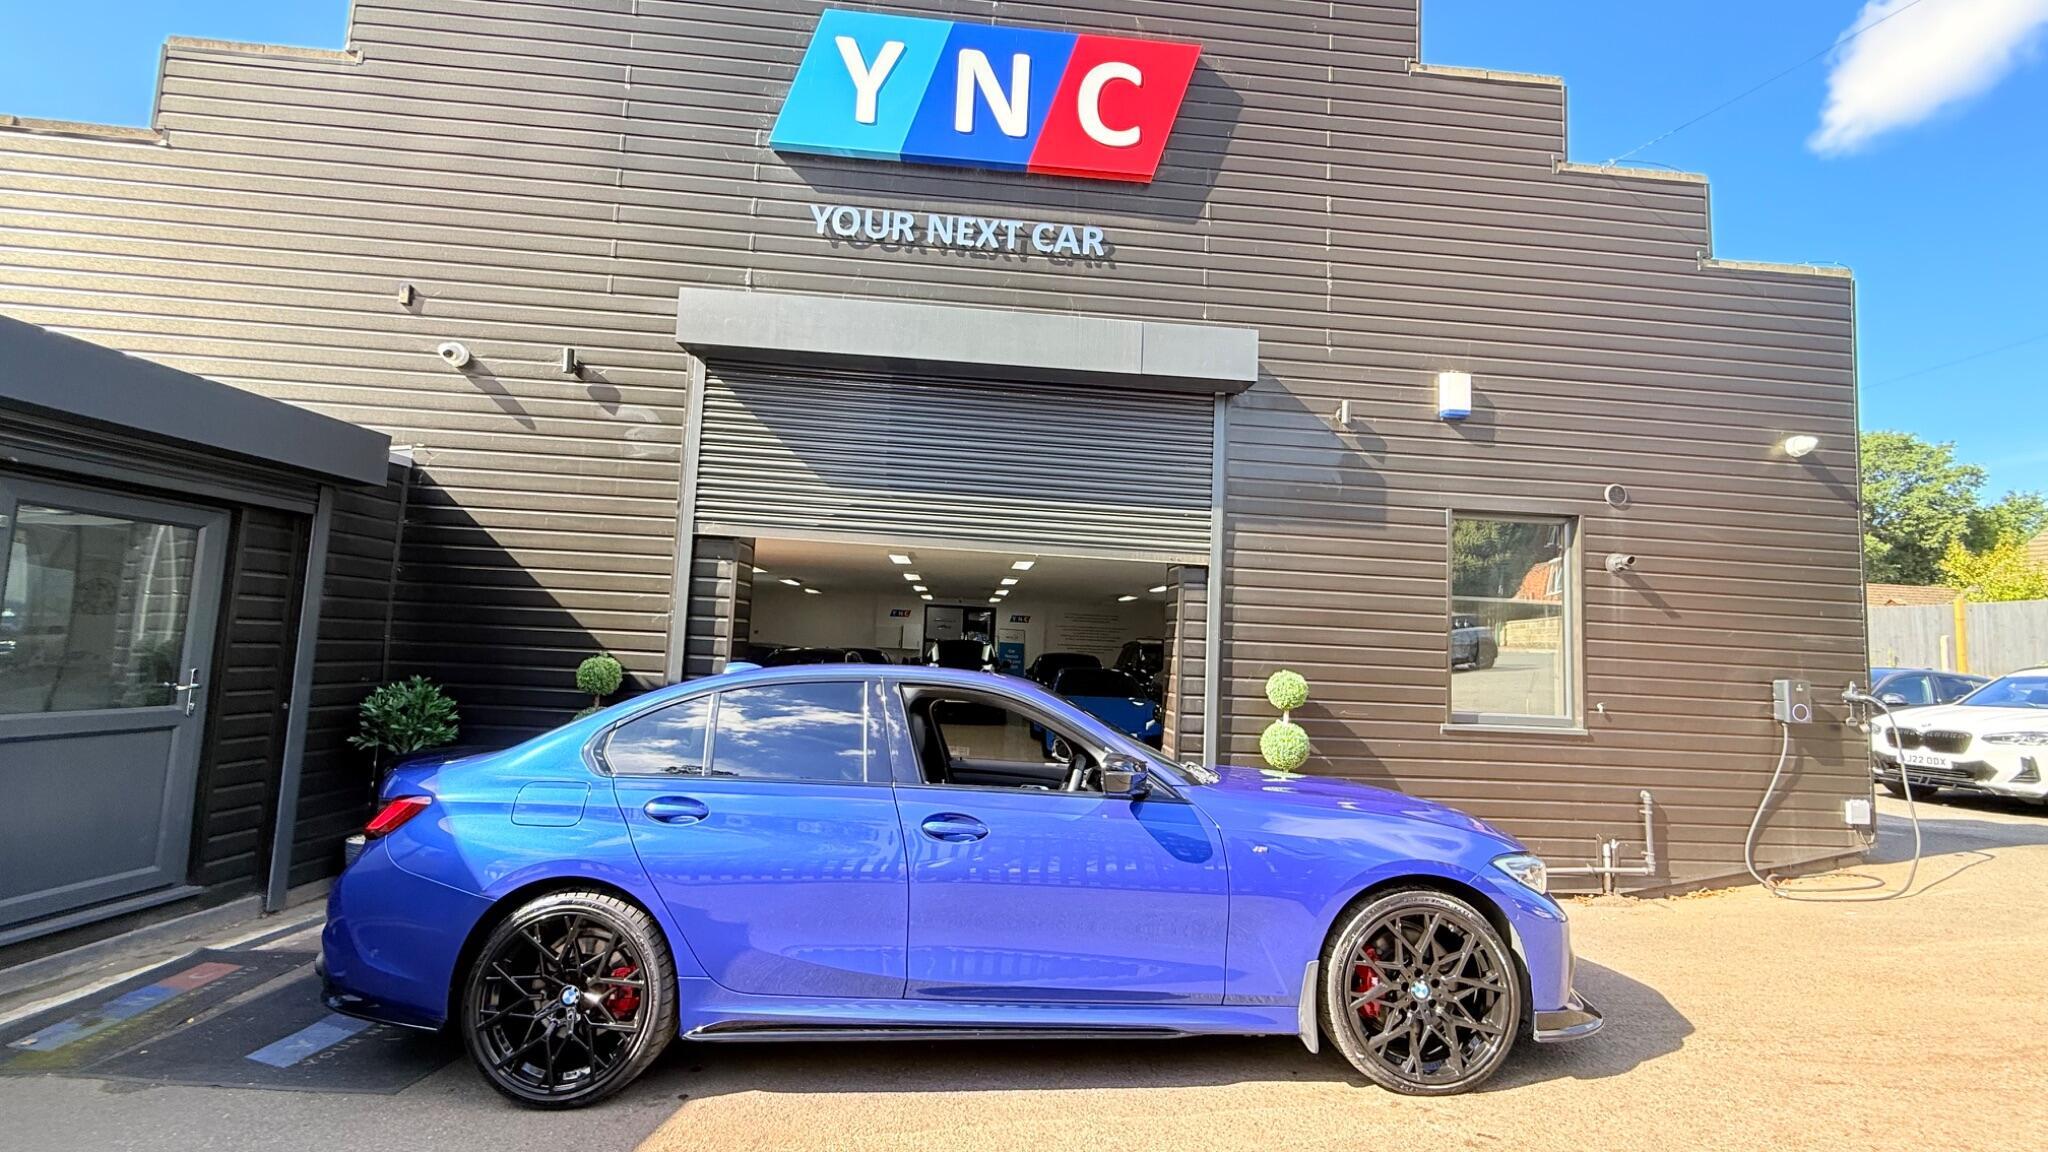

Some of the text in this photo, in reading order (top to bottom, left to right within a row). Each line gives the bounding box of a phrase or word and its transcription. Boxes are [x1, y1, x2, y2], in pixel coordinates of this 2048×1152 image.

[836, 36, 1143, 147] YNC
[810, 204, 1104, 256] YOUR NEXT CAR
